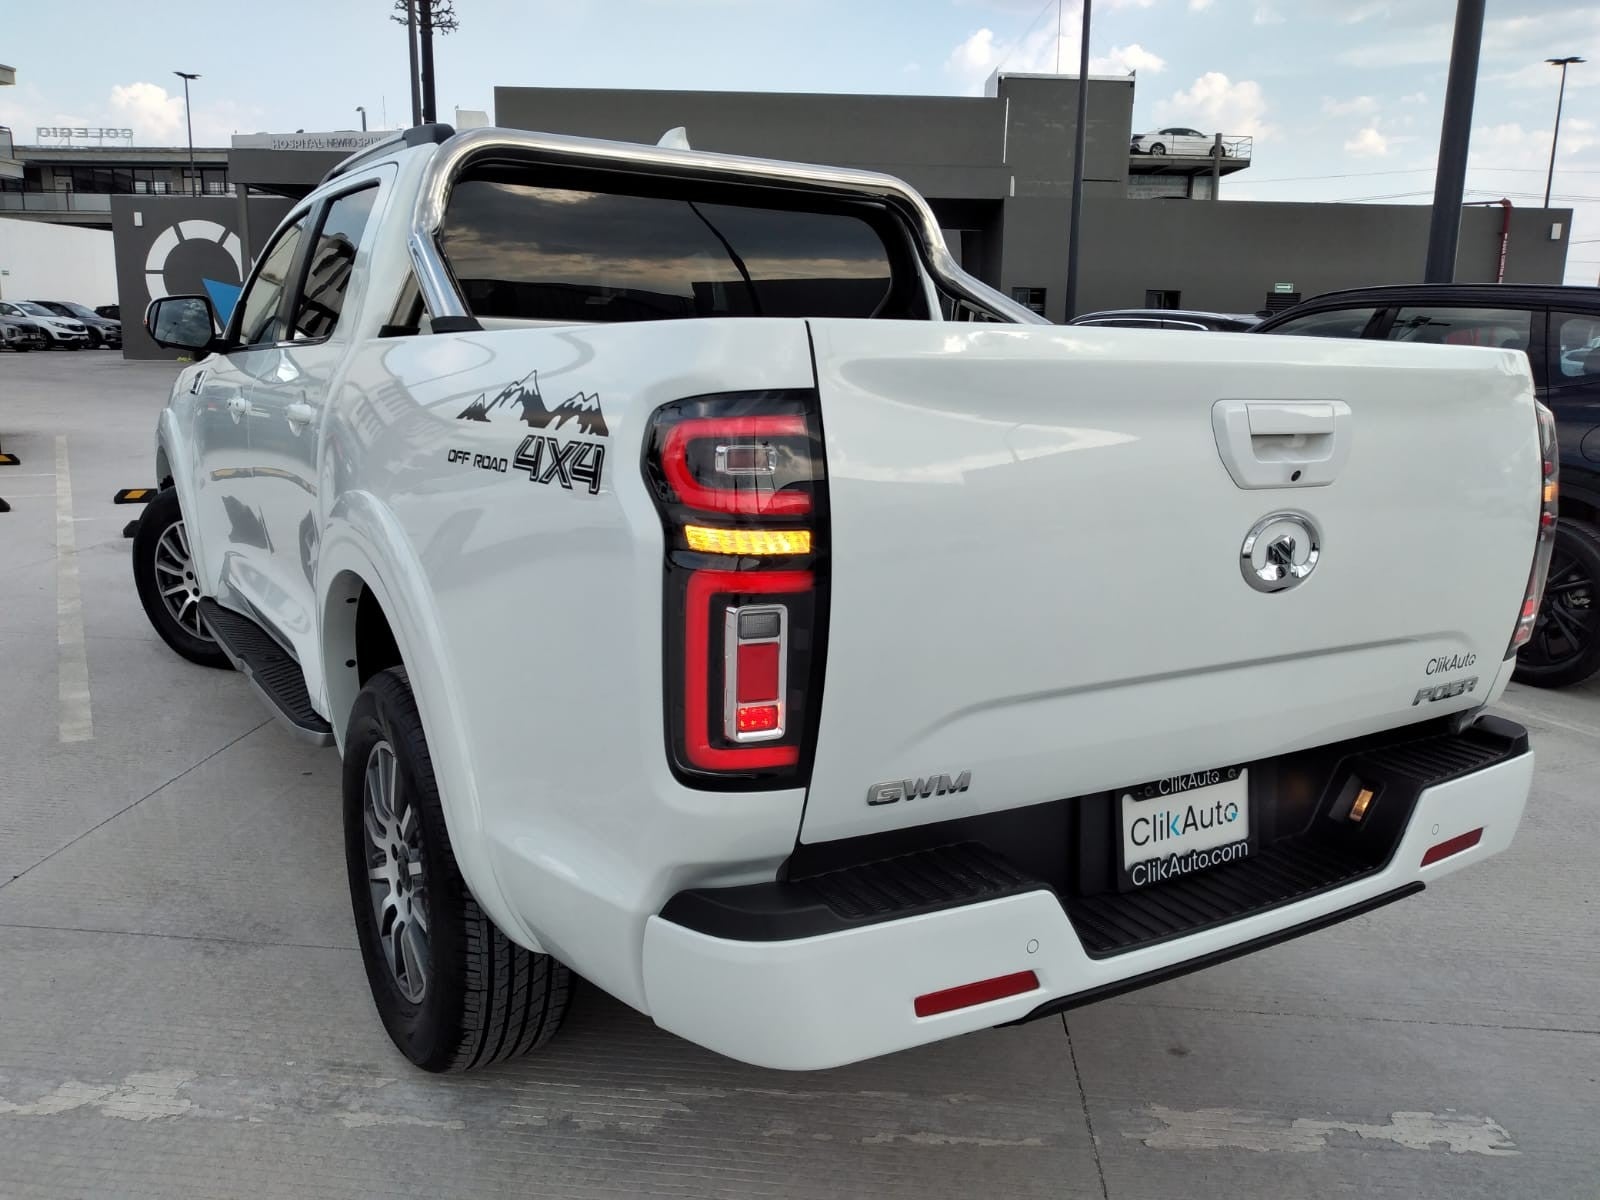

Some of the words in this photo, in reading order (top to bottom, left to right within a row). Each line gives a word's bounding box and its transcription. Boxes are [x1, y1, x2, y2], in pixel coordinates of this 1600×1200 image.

[272, 137, 324, 149] HOSPITAL
[448, 449, 471, 464] OFF
[473, 454, 508, 472] ROAD
[1425, 652, 1477, 675] ClikAuto
[1411, 677, 1479, 706] POER
[866, 770, 972, 806] GWM
[1159, 770, 1220, 795] ClikAuto
[1131, 800, 1239, 846] ClikAuto
[1132, 841, 1249, 886] ClikAuto.com
